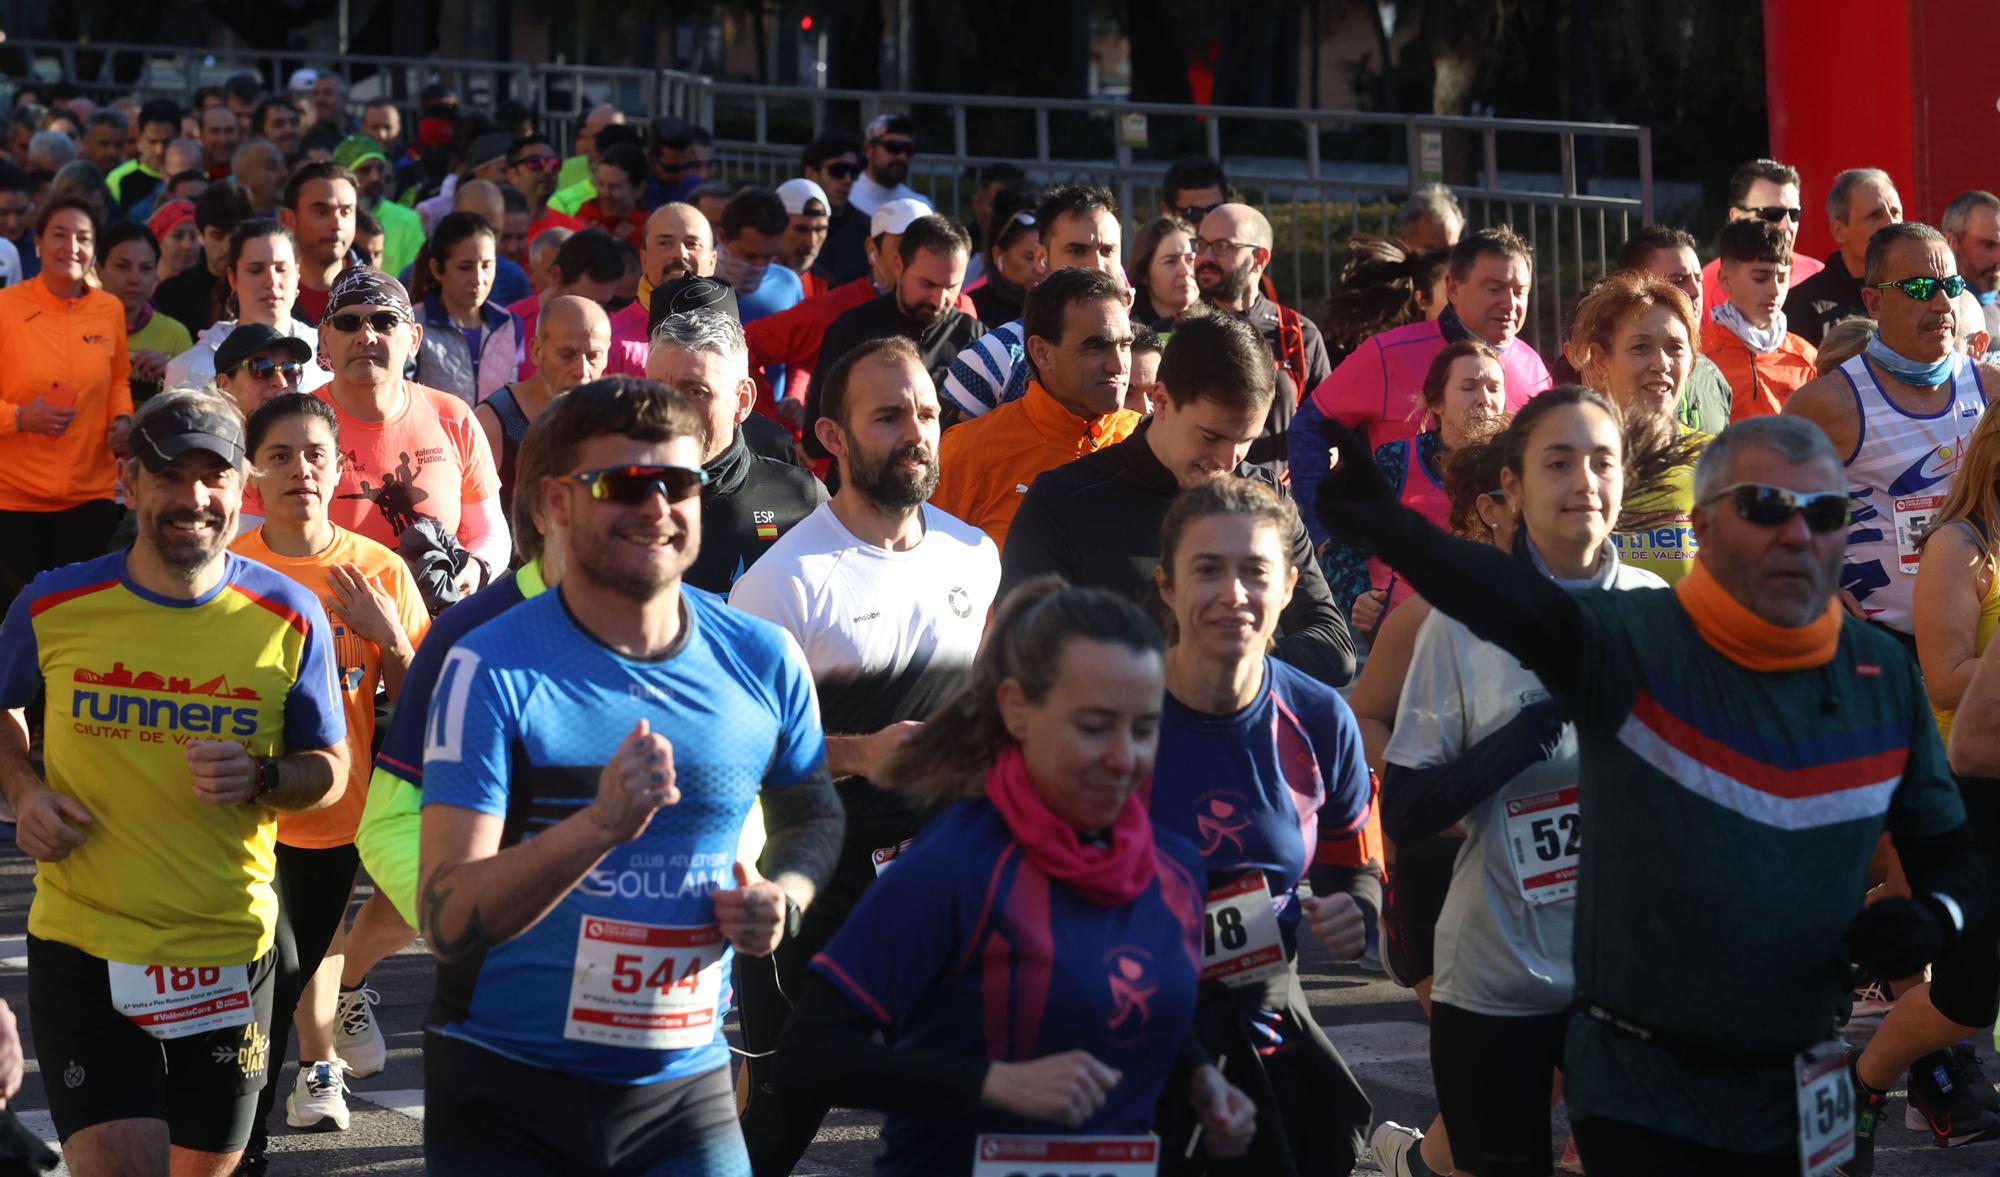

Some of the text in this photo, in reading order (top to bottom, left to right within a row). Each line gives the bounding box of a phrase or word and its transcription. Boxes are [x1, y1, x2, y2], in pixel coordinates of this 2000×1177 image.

[753, 511, 775, 524] ESP
[1609, 527, 1698, 549] nners
[1631, 551, 1648, 560] DE
[72, 689, 258, 737] runners
[73, 723, 131, 740] CIUTAT
[140, 731, 164, 743] DE
[1531, 813, 1582, 861] 52
[611, 953, 702, 996] 544
[153, 1006, 212, 1021] #ValènciaCorre
